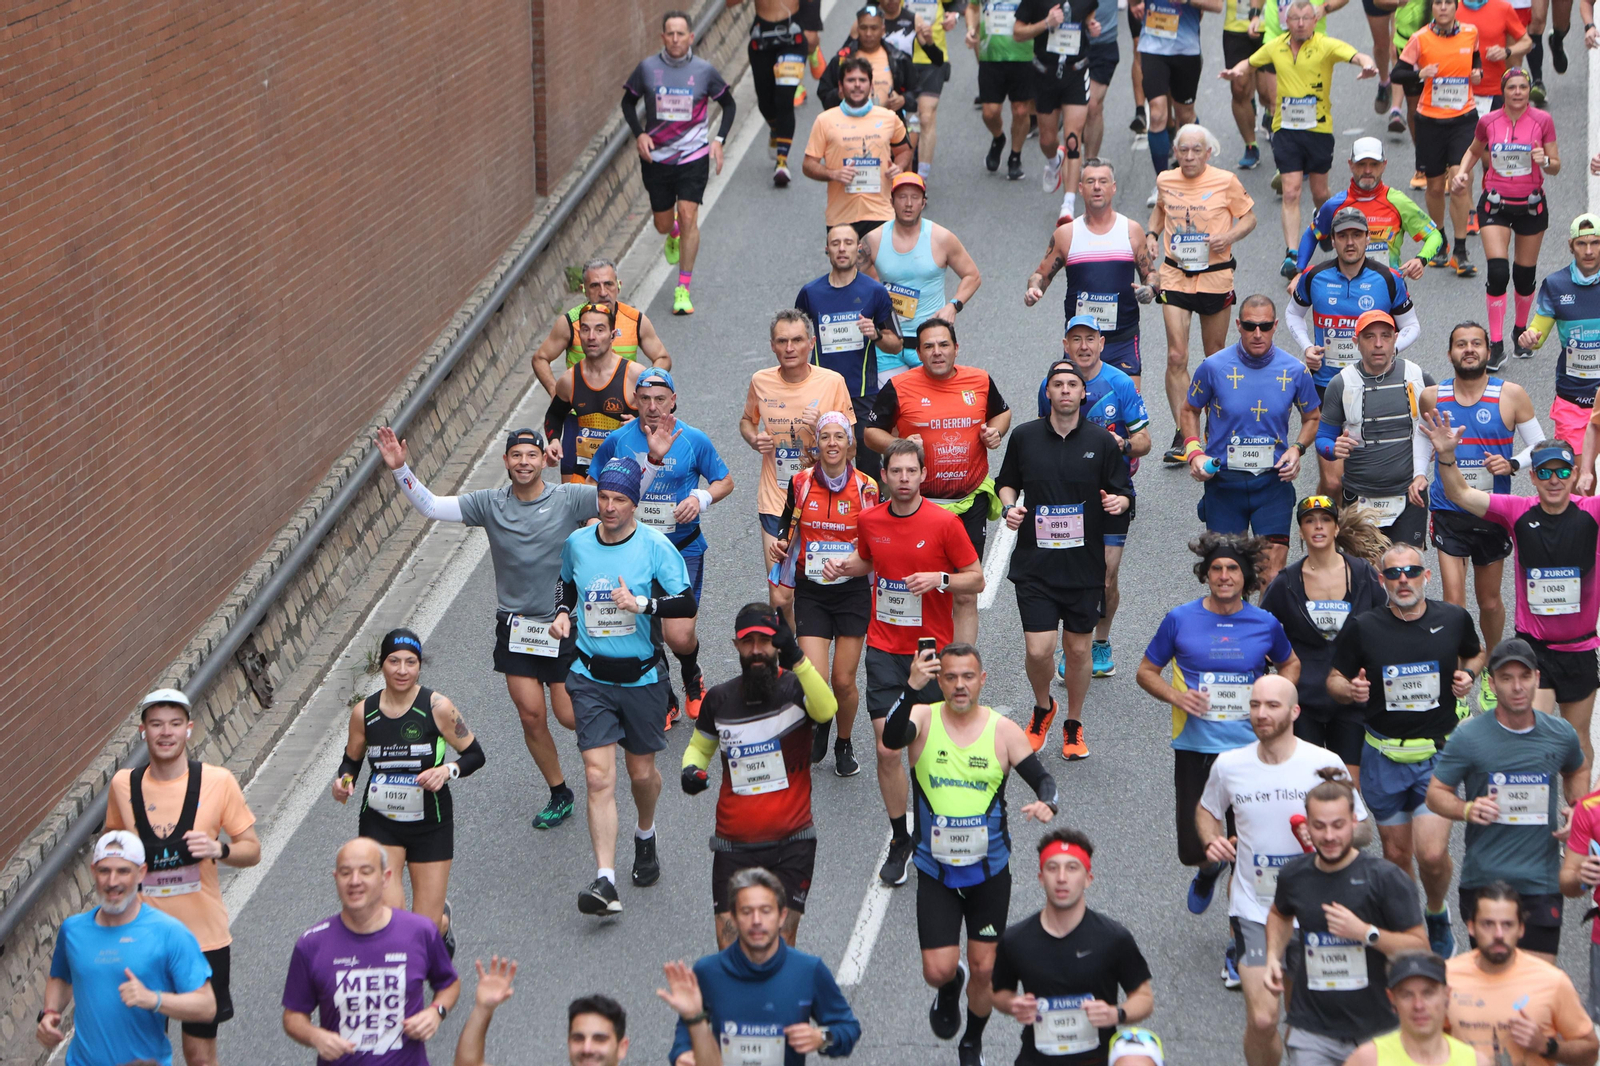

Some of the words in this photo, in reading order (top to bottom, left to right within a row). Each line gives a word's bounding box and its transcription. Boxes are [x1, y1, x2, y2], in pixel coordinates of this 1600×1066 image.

[856, 159, 878, 167] ZURICH
[891, 285, 916, 297] ZURICH
[1090, 294, 1114, 302] ZURICH
[832, 314, 857, 323] ZURICH
[833, 327, 848, 335] 9400
[930, 418, 941, 430] CA
[942, 417, 972, 429] GERENA
[1242, 436, 1270, 444] ZURICH
[645, 493, 672, 501] ZURICH
[644, 507, 661, 515] 8455
[1051, 506, 1078, 515] ZURICH
[811, 520, 821, 530] CA
[821, 521, 846, 532] GERENA
[822, 543, 850, 551] ZURICH
[1543, 569, 1575, 578] ZURICH
[888, 596, 905, 605] 9957
[1319, 601, 1349, 610] ZURICH
[600, 607, 618, 615] 8307
[1316, 617, 1337, 626] 10381
[527, 625, 545, 635] 9047
[520, 637, 549, 646] ROCAROCA
[1217, 674, 1249, 684] ZURICH
[1402, 681, 1423, 690] 9316
[1217, 691, 1237, 699] 9608
[743, 742, 775, 757] ZURICH
[746, 761, 766, 771] 9874
[746, 774, 771, 784] VIKINGO
[1508, 774, 1543, 784] ZURICH
[384, 791, 407, 800] 10137
[1235, 792, 1253, 805] Run
[1508, 791, 1529, 800] 9432
[950, 817, 982, 827] ZURICH
[950, 834, 970, 843] 9907
[156, 877, 183, 886] STEVEN
[343, 974, 399, 993] MER
[346, 994, 399, 1011] ENG
[345, 1013, 399, 1030] UES
[741, 1024, 778, 1036] ZURICH
[740, 1046, 762, 1054] 9141
